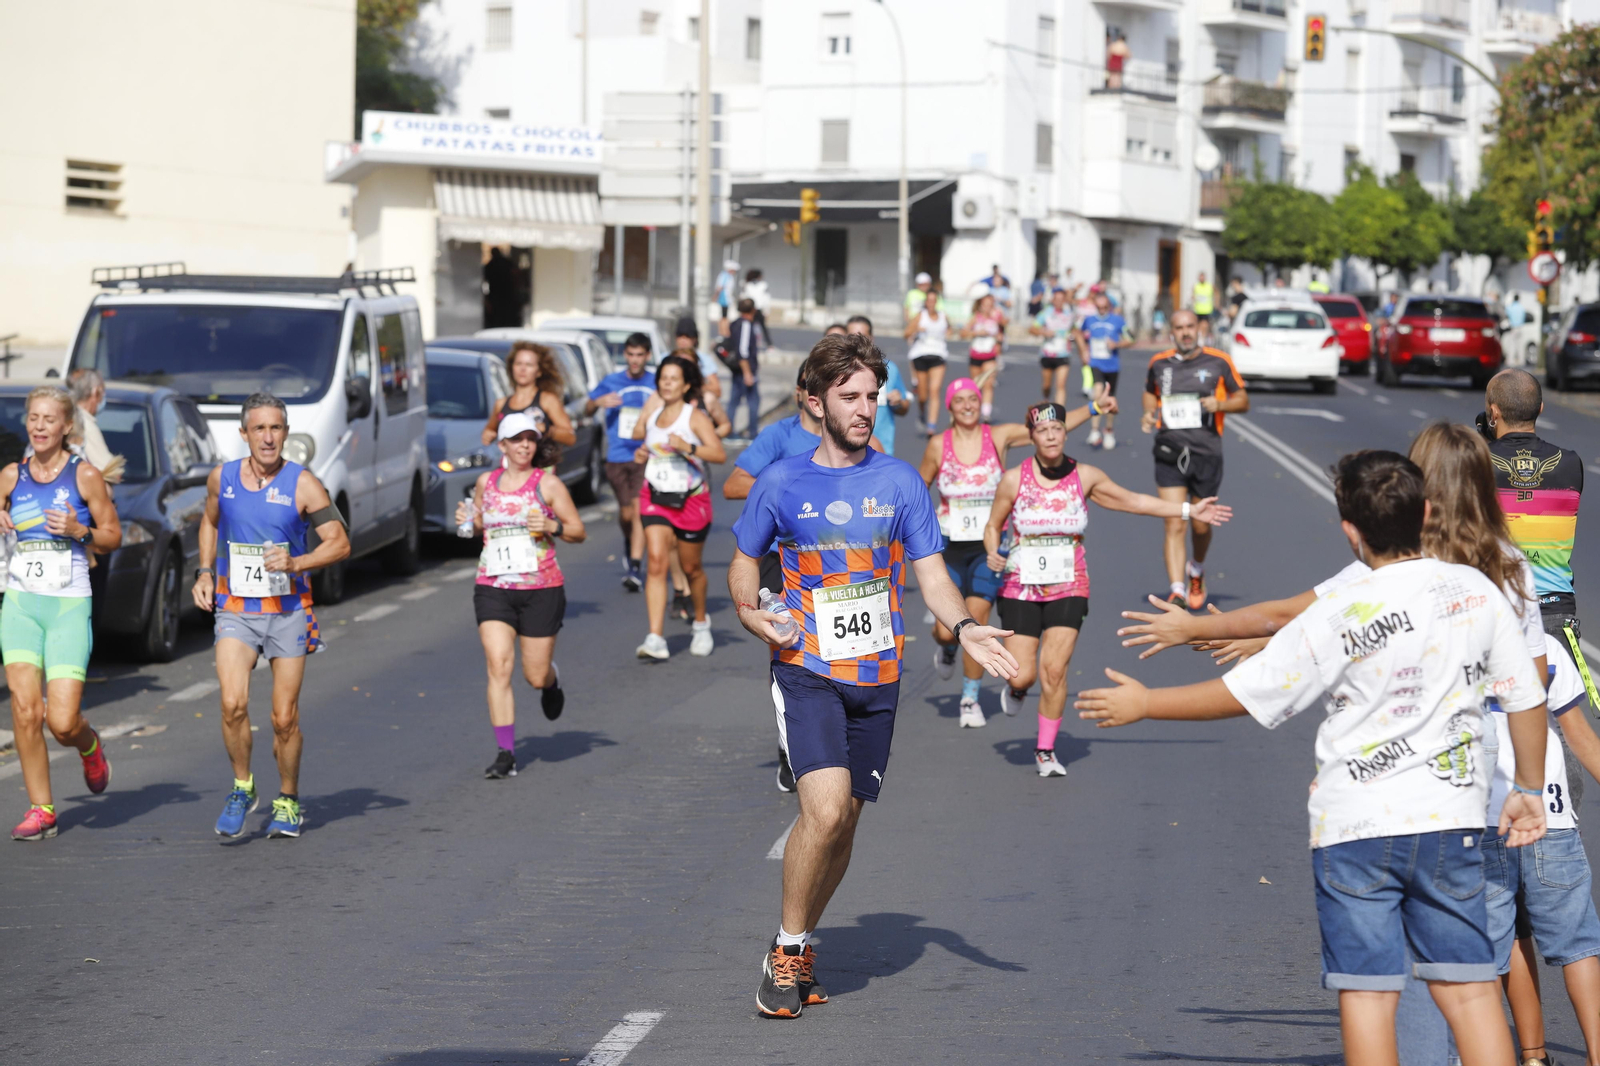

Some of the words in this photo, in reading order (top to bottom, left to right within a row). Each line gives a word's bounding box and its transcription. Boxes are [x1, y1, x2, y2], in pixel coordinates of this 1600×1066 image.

[394, 119, 492, 135] CHURROS
[422, 137, 515, 152] PATATAS
[523, 143, 595, 157] FRITAS
[797, 511, 819, 520] VIATOR
[963, 515, 977, 529] 91
[497, 546, 510, 561] 11
[26, 561, 44, 578] 73
[1038, 555, 1047, 571] 9
[244, 565, 263, 582] 74
[830, 587, 858, 600] VUELTA
[859, 586, 864, 597] A
[866, 582, 884, 595] HUELVA
[838, 600, 859, 608] MARIO
[833, 611, 872, 640] 548
